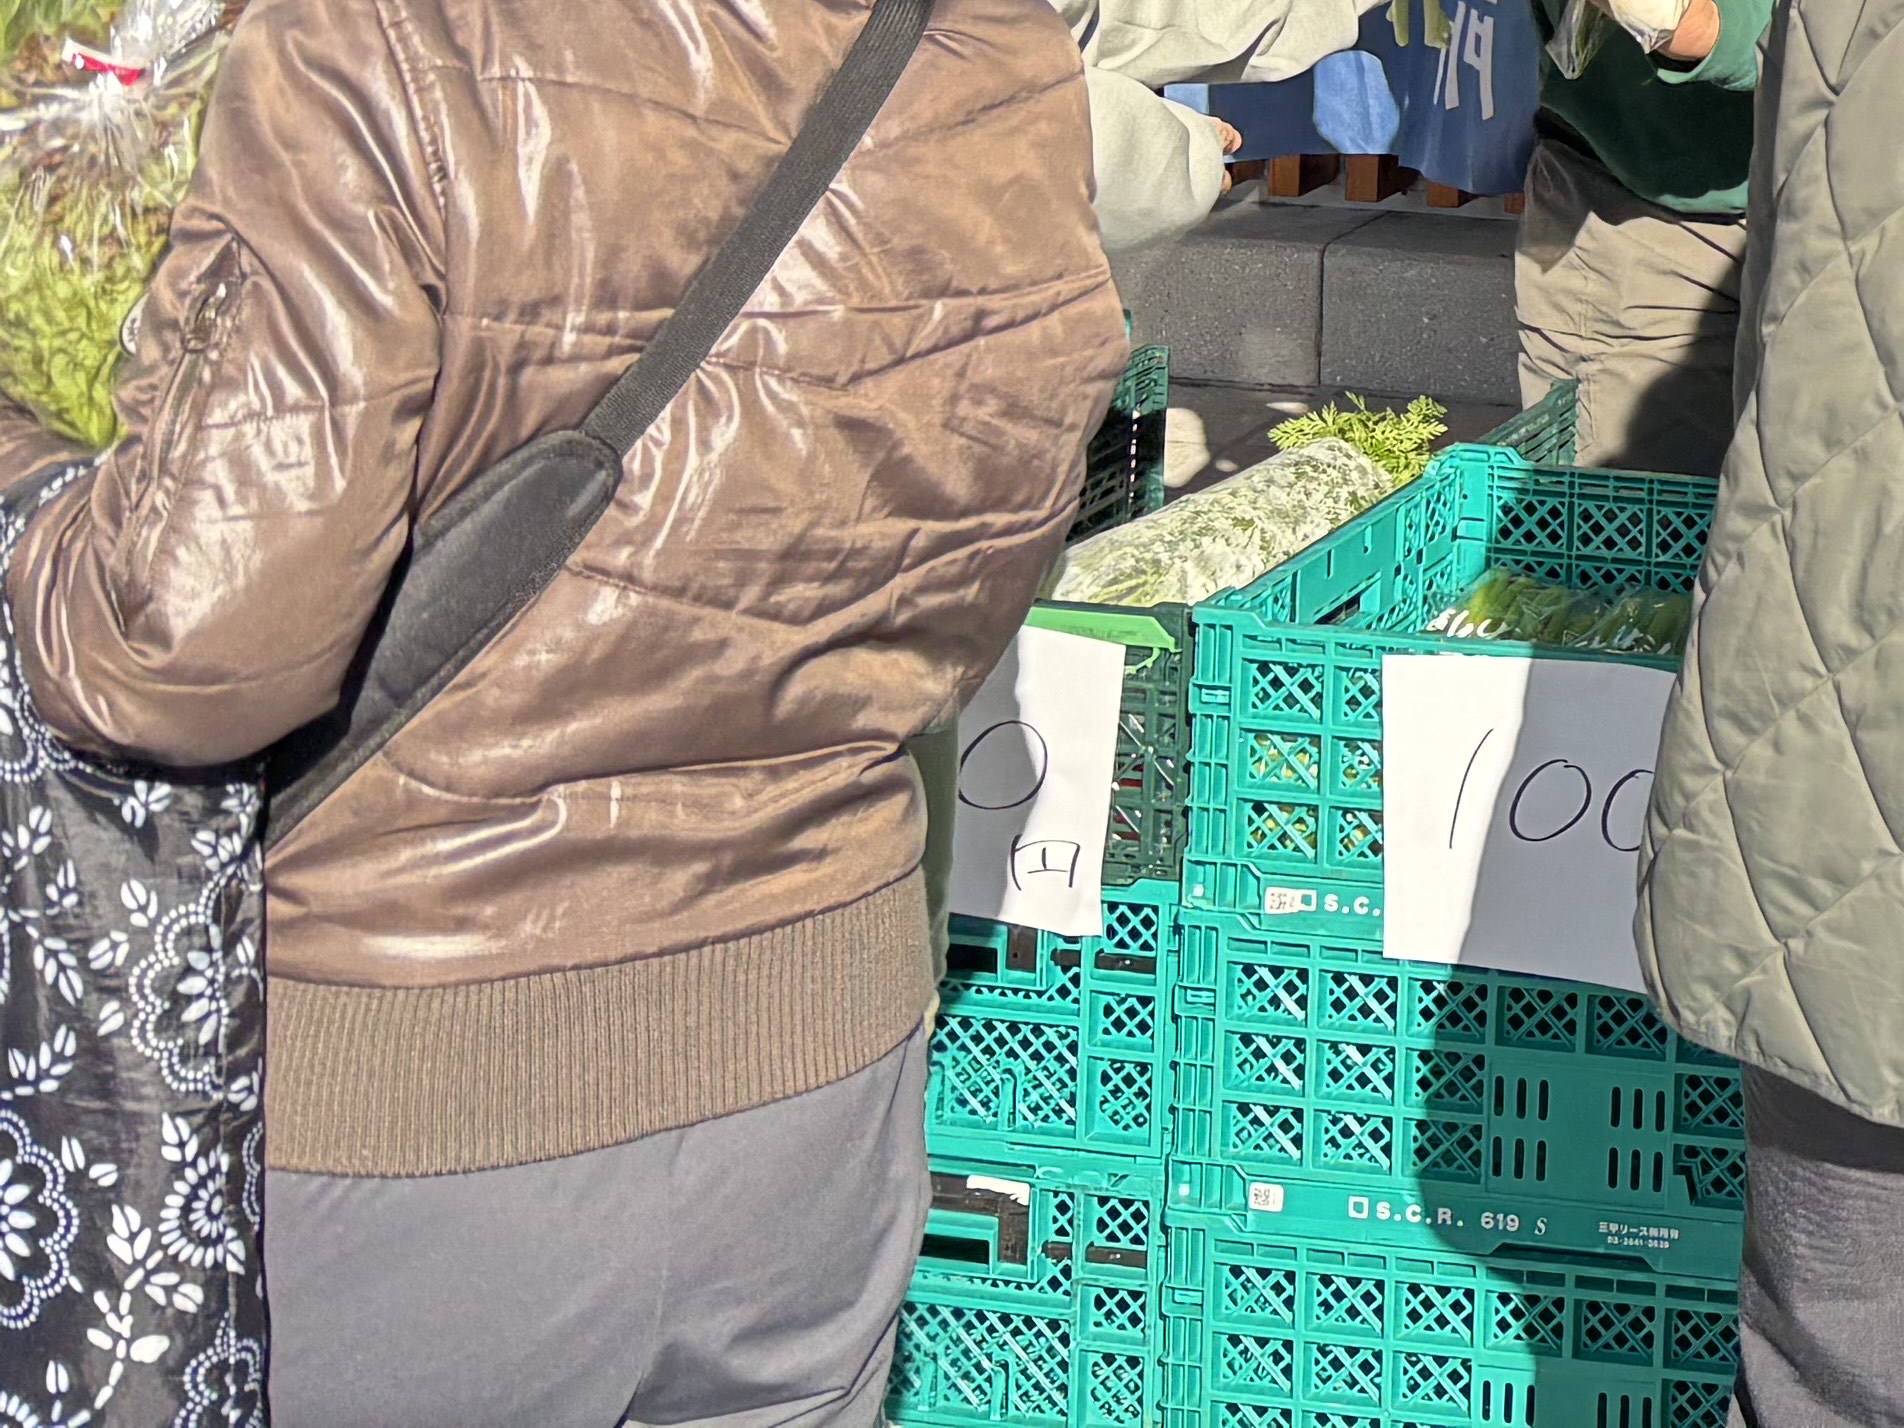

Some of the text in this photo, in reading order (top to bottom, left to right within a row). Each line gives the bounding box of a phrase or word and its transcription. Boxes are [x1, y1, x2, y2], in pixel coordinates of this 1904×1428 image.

[1448, 727, 1653, 853] 100
[1375, 1200, 1464, 1228] S.C.R.
[1480, 1211, 1520, 1233] 619
